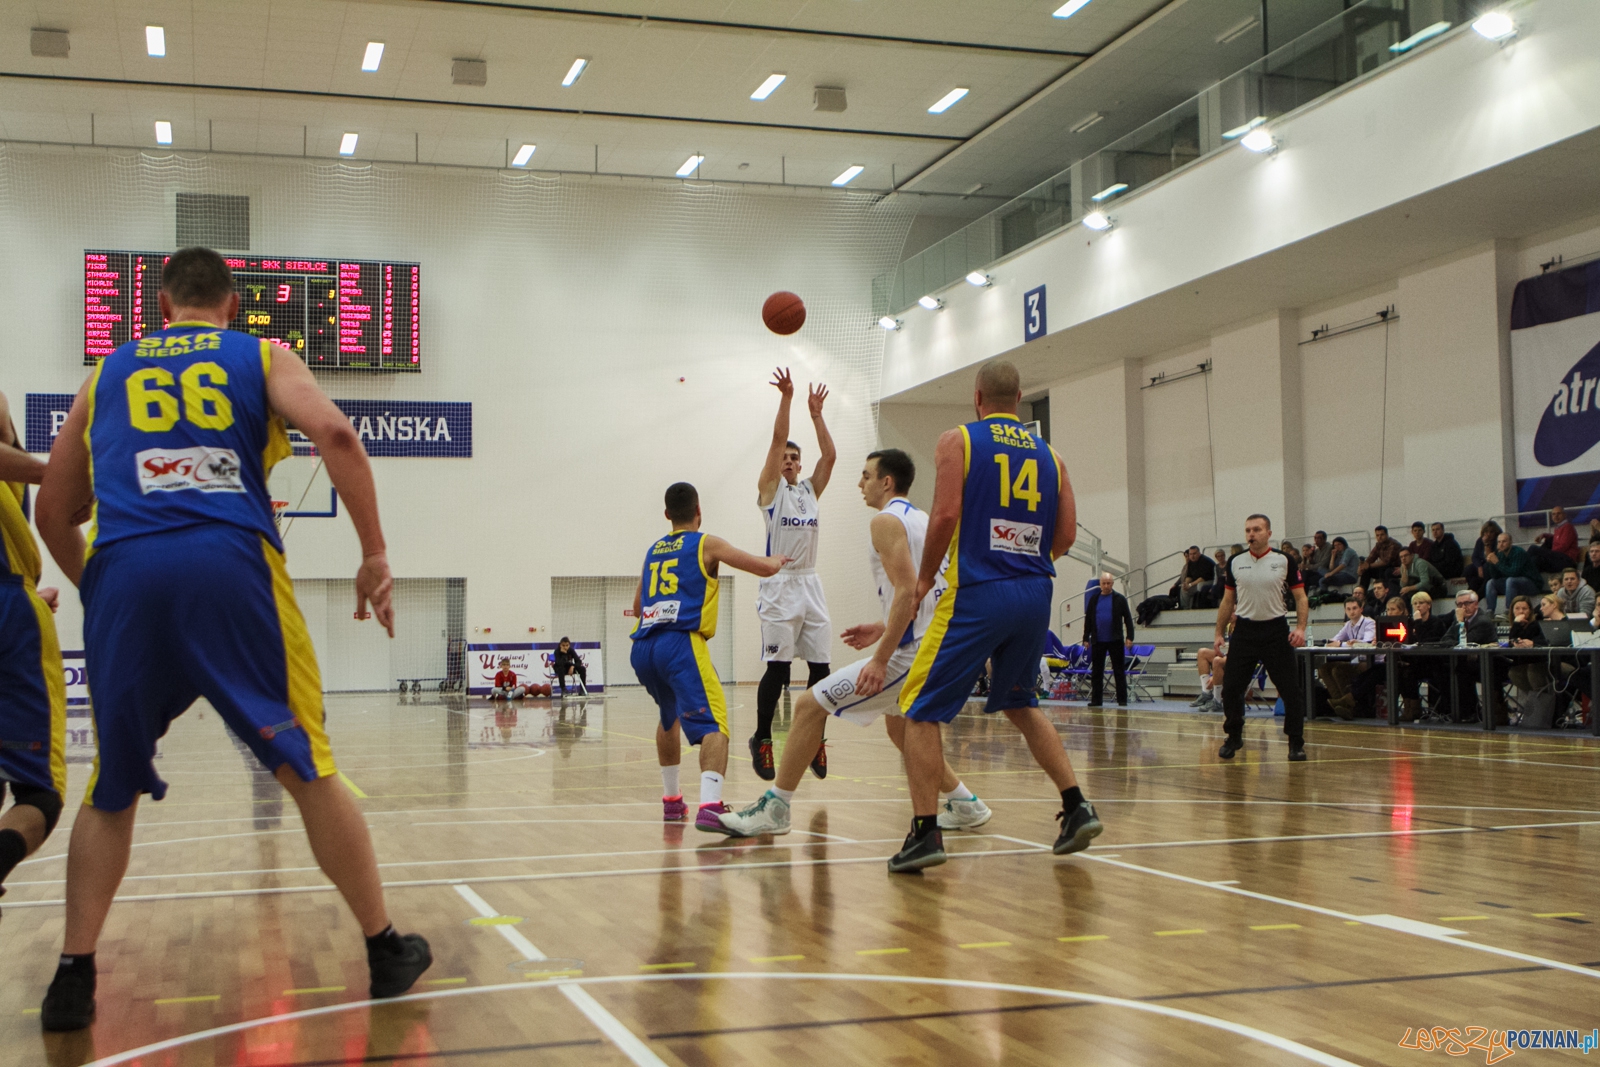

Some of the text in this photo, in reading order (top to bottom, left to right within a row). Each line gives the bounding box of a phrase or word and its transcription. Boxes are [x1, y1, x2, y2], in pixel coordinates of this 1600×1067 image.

[262, 260, 280, 270] SKK
[286, 261, 328, 272] SIEDLCE
[276, 284, 291, 303] 3
[328, 290, 336, 299] 3
[248, 315, 270, 324] 0:00
[328, 316, 336, 325] 4
[1028, 292, 1040, 334] 3
[134, 340, 221, 358] SIEDLCE
[136, 331, 223, 349] SKK
[296, 339, 304, 348] 0
[126, 362, 235, 432] 66
[989, 424, 1034, 442] SKK
[993, 434, 1037, 450] SIEDLCE
[994, 452, 1042, 512] 14
[781, 517, 818, 528] BIOFAR
[652, 544, 683, 555] SIEDLCE
[648, 558, 679, 598] 15
[830, 679, 854, 700] 8
